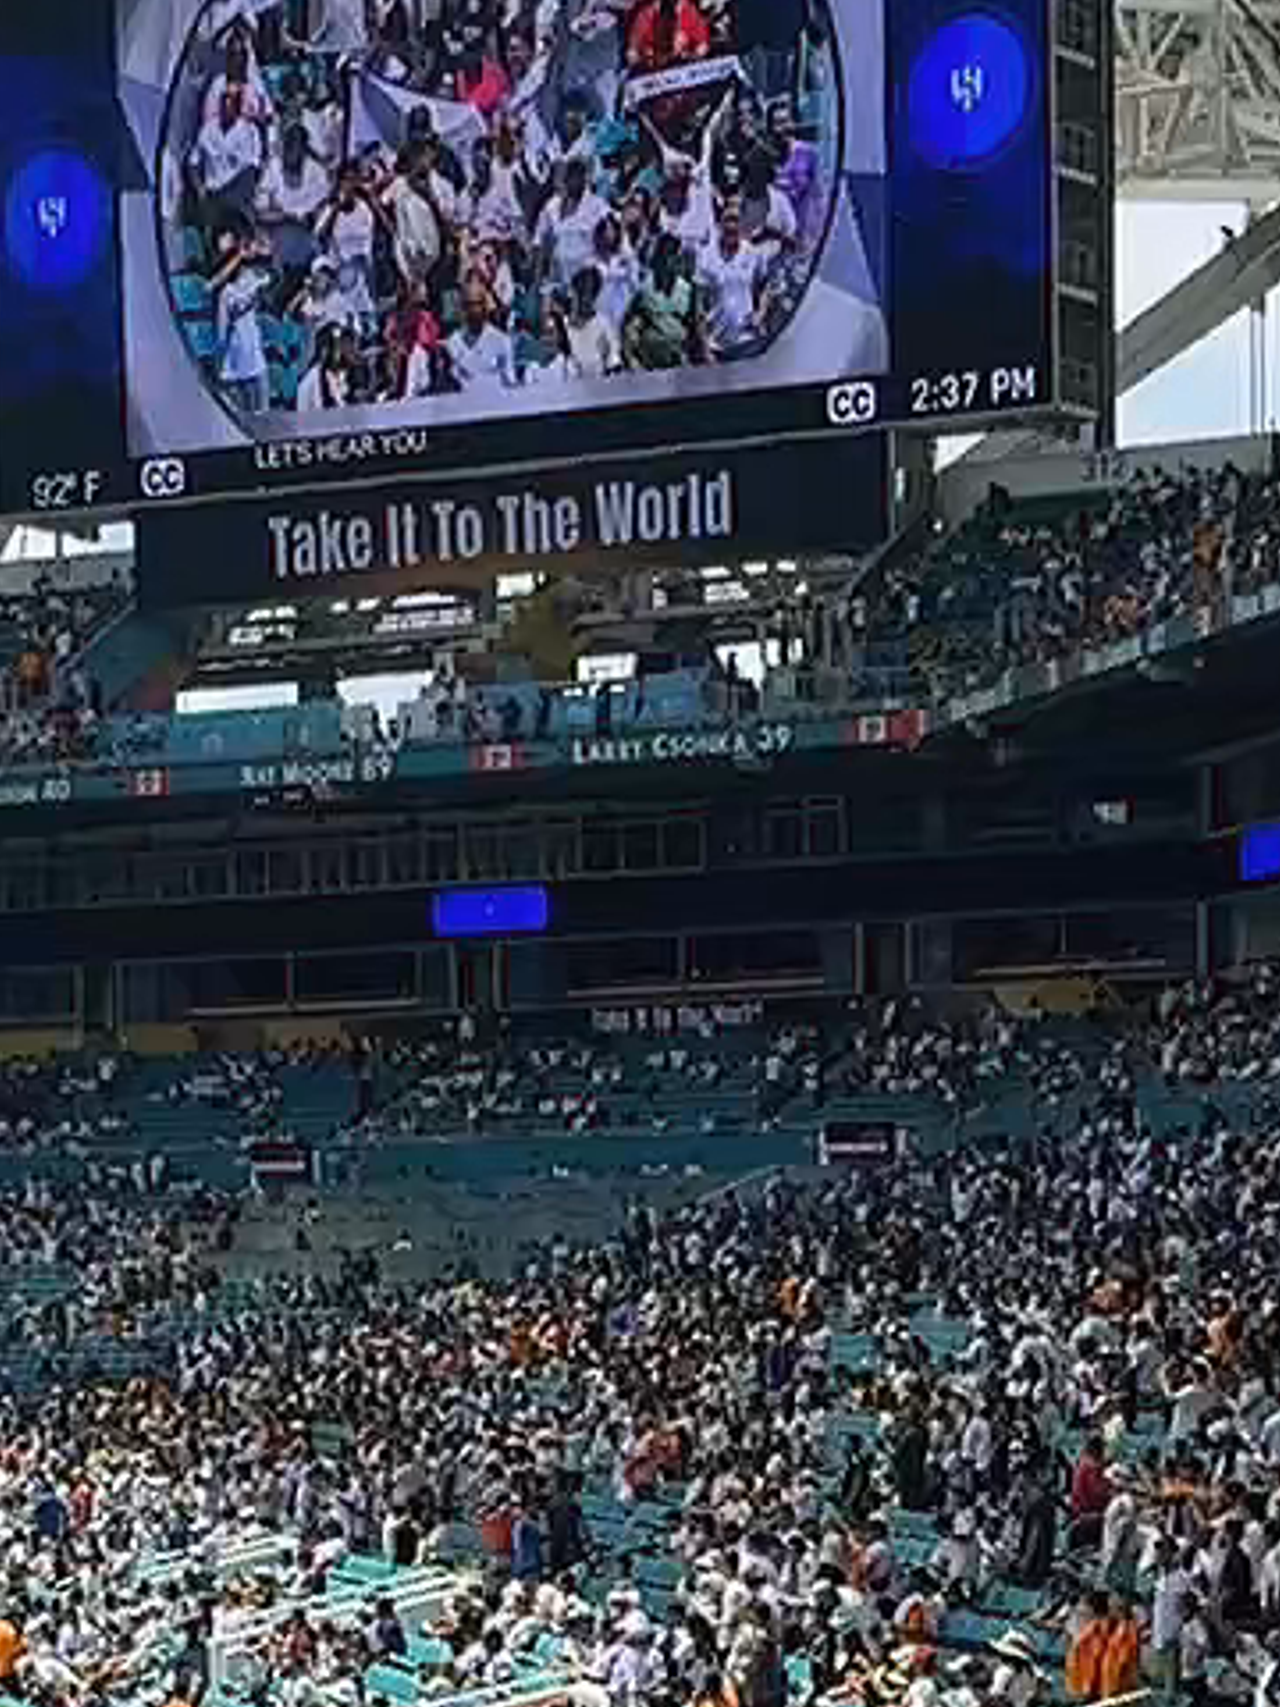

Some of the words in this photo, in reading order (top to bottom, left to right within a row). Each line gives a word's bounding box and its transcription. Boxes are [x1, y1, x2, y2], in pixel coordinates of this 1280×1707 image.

[829, 383, 874, 422] CC
[911, 374, 978, 412] 2:37
[990, 367, 1036, 403] PM
[317, 435, 377, 461] HEAR
[380, 430, 427, 454] YOU
[84, 471, 100, 503] F
[143, 462, 183, 494] CC
[269, 507, 372, 579] Take
[387, 504, 422, 566] It
[431, 502, 483, 559] To
[502, 496, 580, 555] The
[596, 470, 733, 545] World
